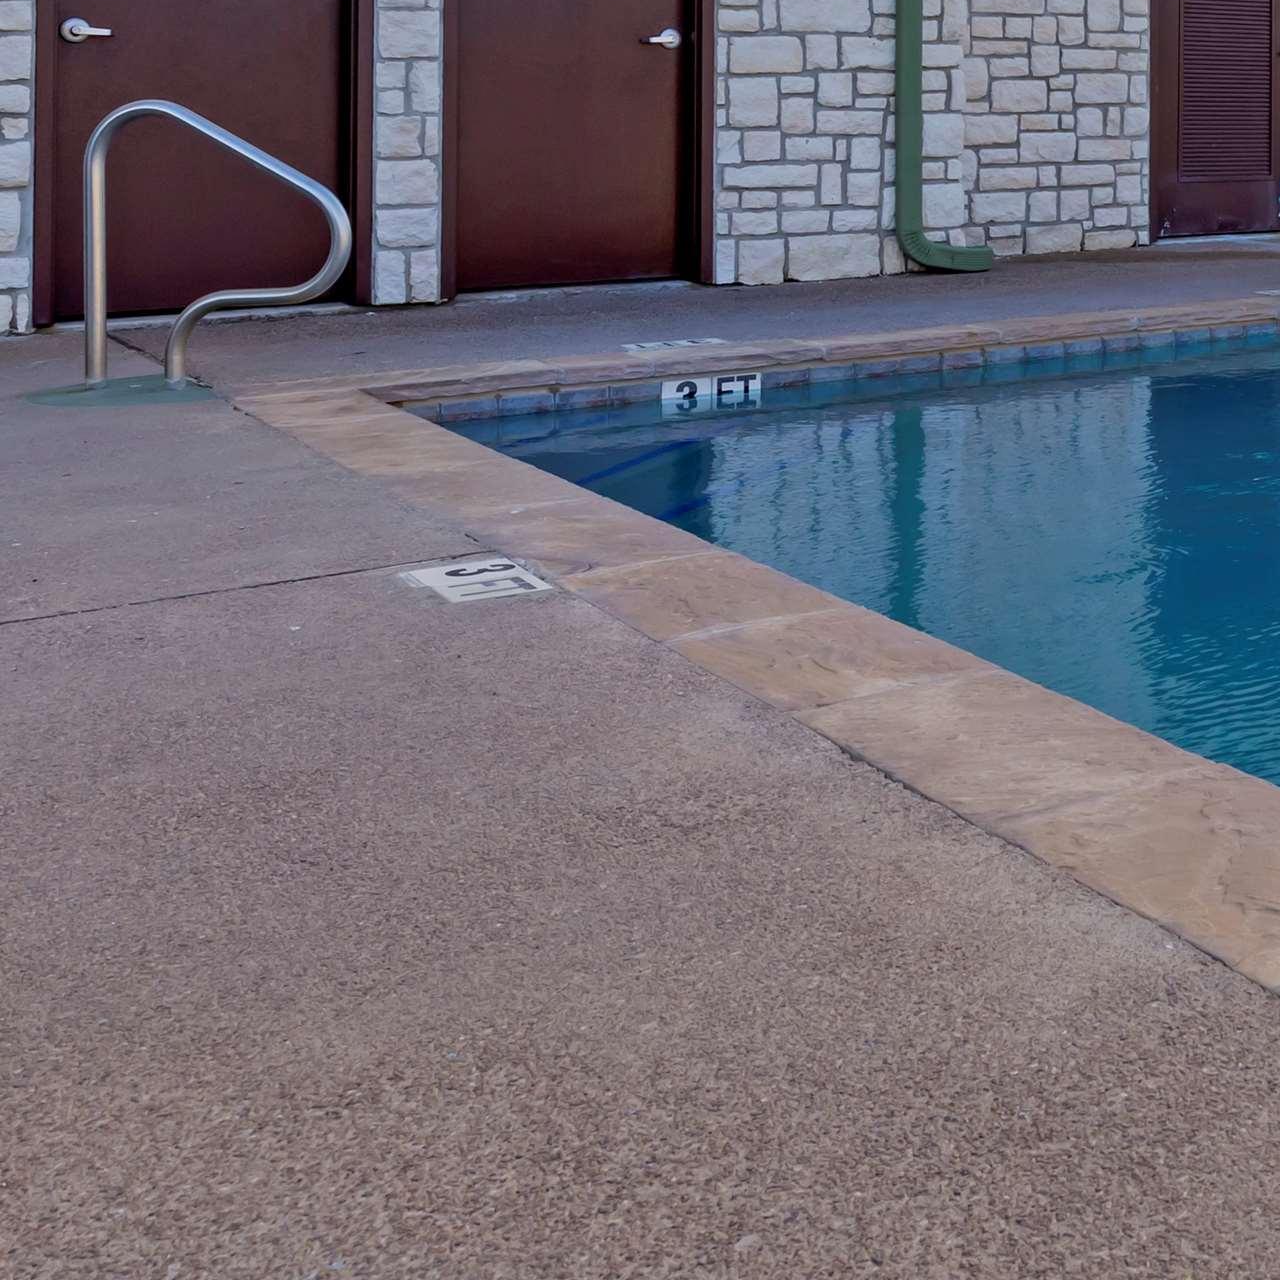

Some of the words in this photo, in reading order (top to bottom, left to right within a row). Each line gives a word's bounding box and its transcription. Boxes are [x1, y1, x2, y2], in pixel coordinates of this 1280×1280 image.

[717, 373, 757, 396] FT
[444, 563, 516, 577] 3
[448, 576, 537, 597] FT
